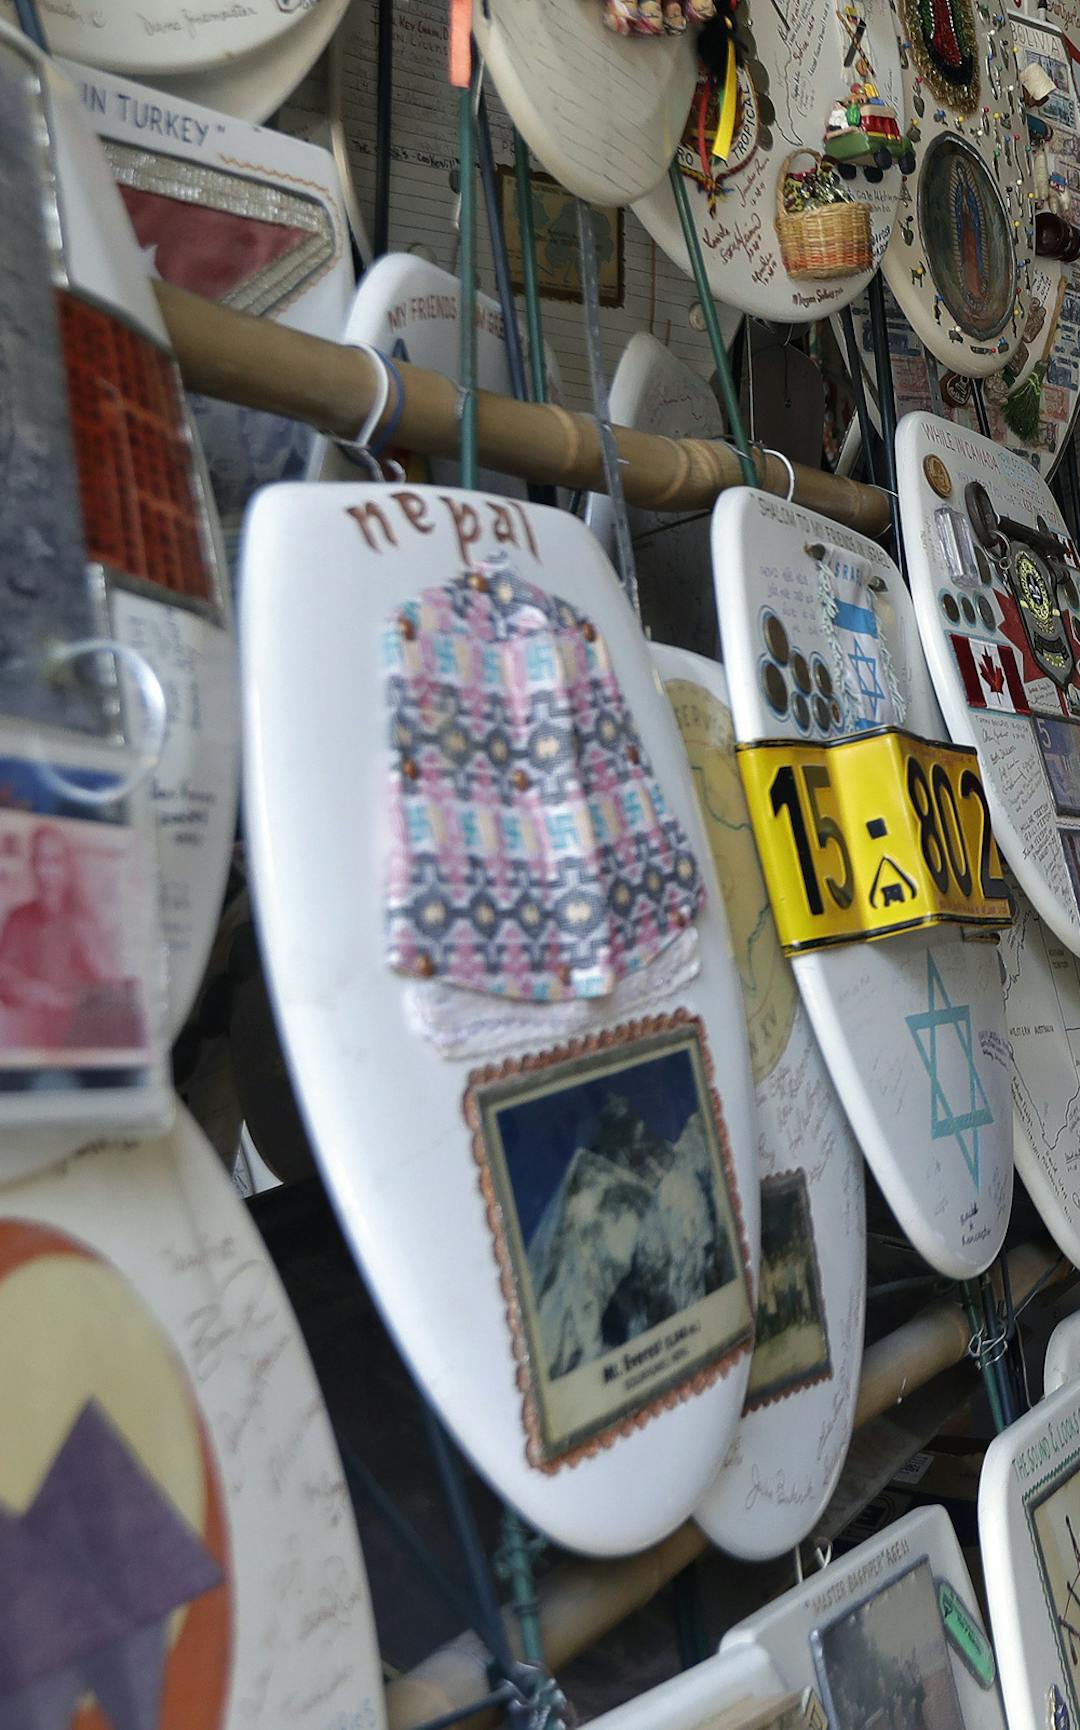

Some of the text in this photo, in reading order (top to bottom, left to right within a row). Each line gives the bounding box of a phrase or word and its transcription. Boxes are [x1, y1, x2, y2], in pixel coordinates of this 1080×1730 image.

[1009, 21, 1061, 54] BOLIVIA
[117, 93, 210, 146] TURKEY
[730, 83, 757, 161] TROPICAL
[410, 295, 458, 322] FRIENDS
[345, 491, 543, 567] nepal
[769, 765, 854, 916] 15
[906, 754, 1009, 900] 802
[1011, 1449, 1031, 1482] THE
